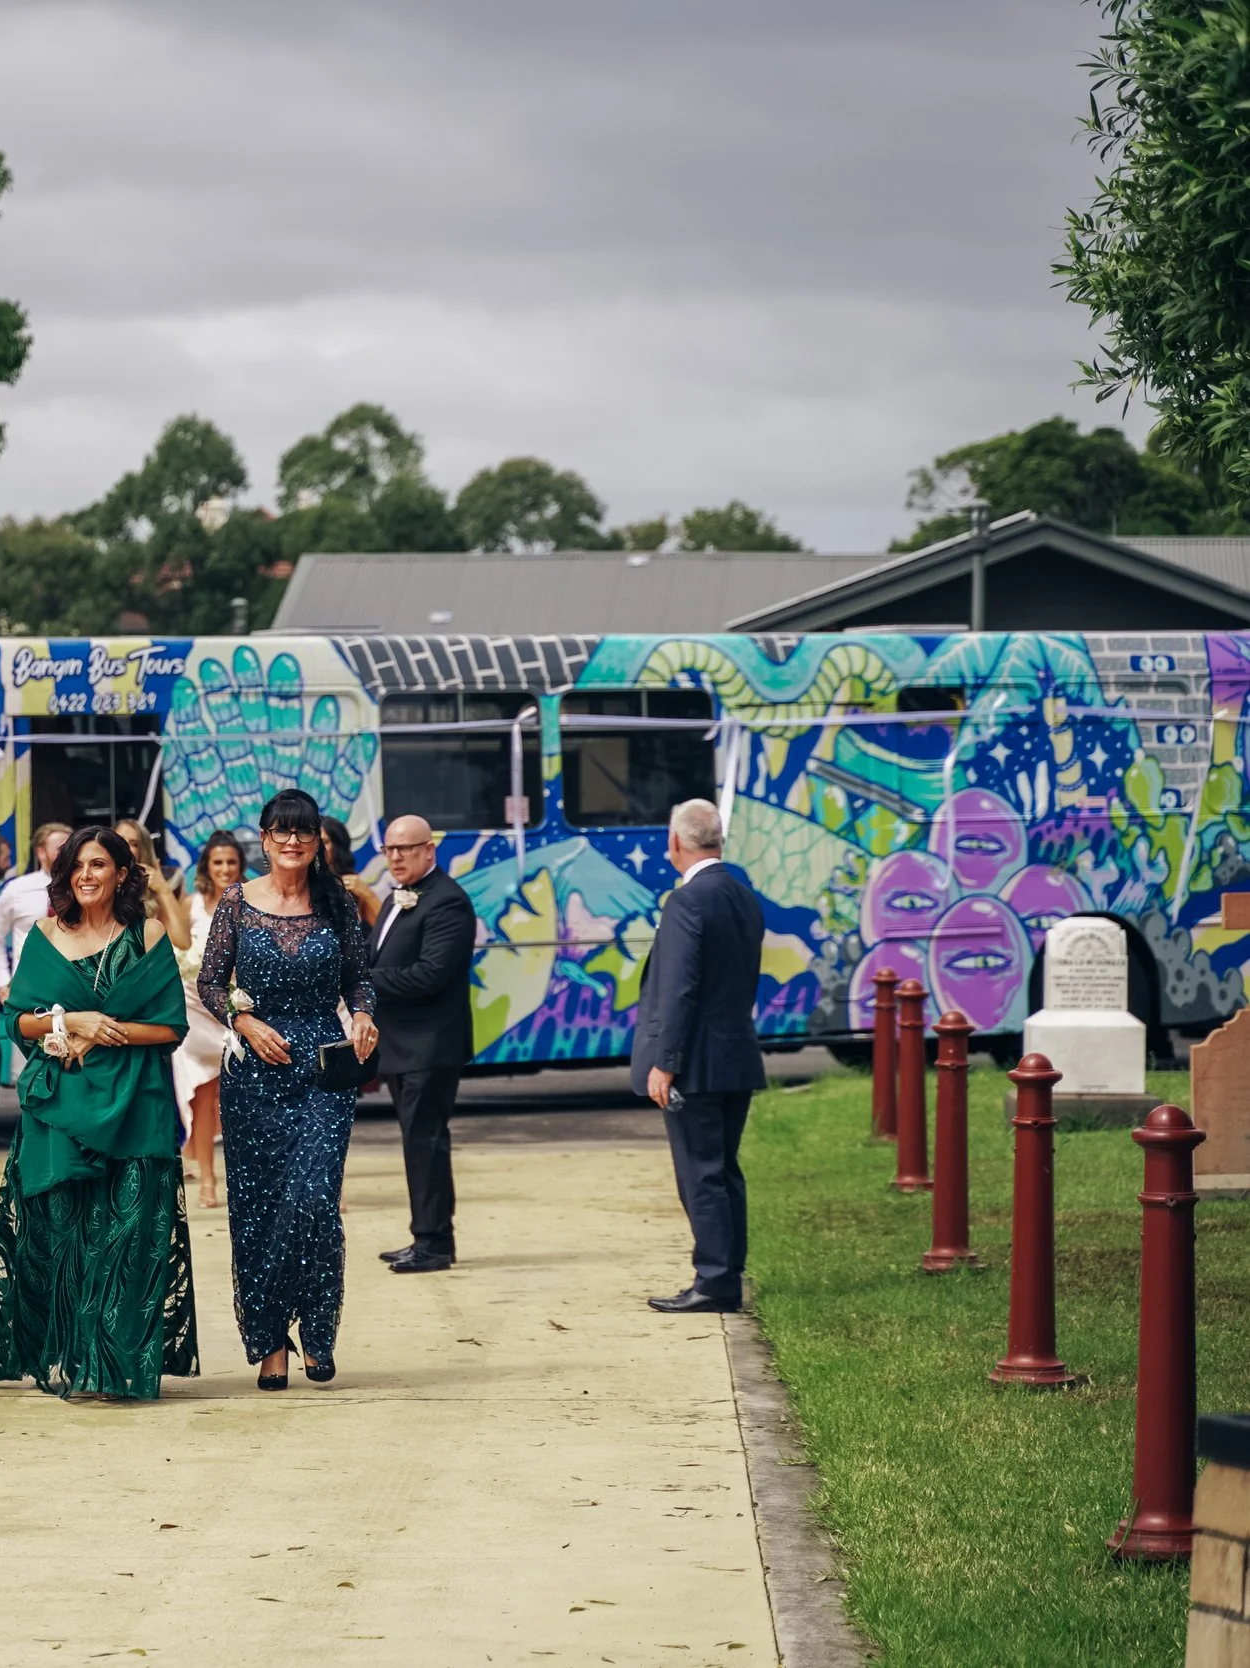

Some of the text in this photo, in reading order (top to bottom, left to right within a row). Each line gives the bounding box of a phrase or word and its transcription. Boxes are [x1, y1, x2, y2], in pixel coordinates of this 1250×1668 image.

[87, 645, 128, 686] Bus
[127, 645, 186, 686] Tours
[49, 692, 87, 713] 0422
